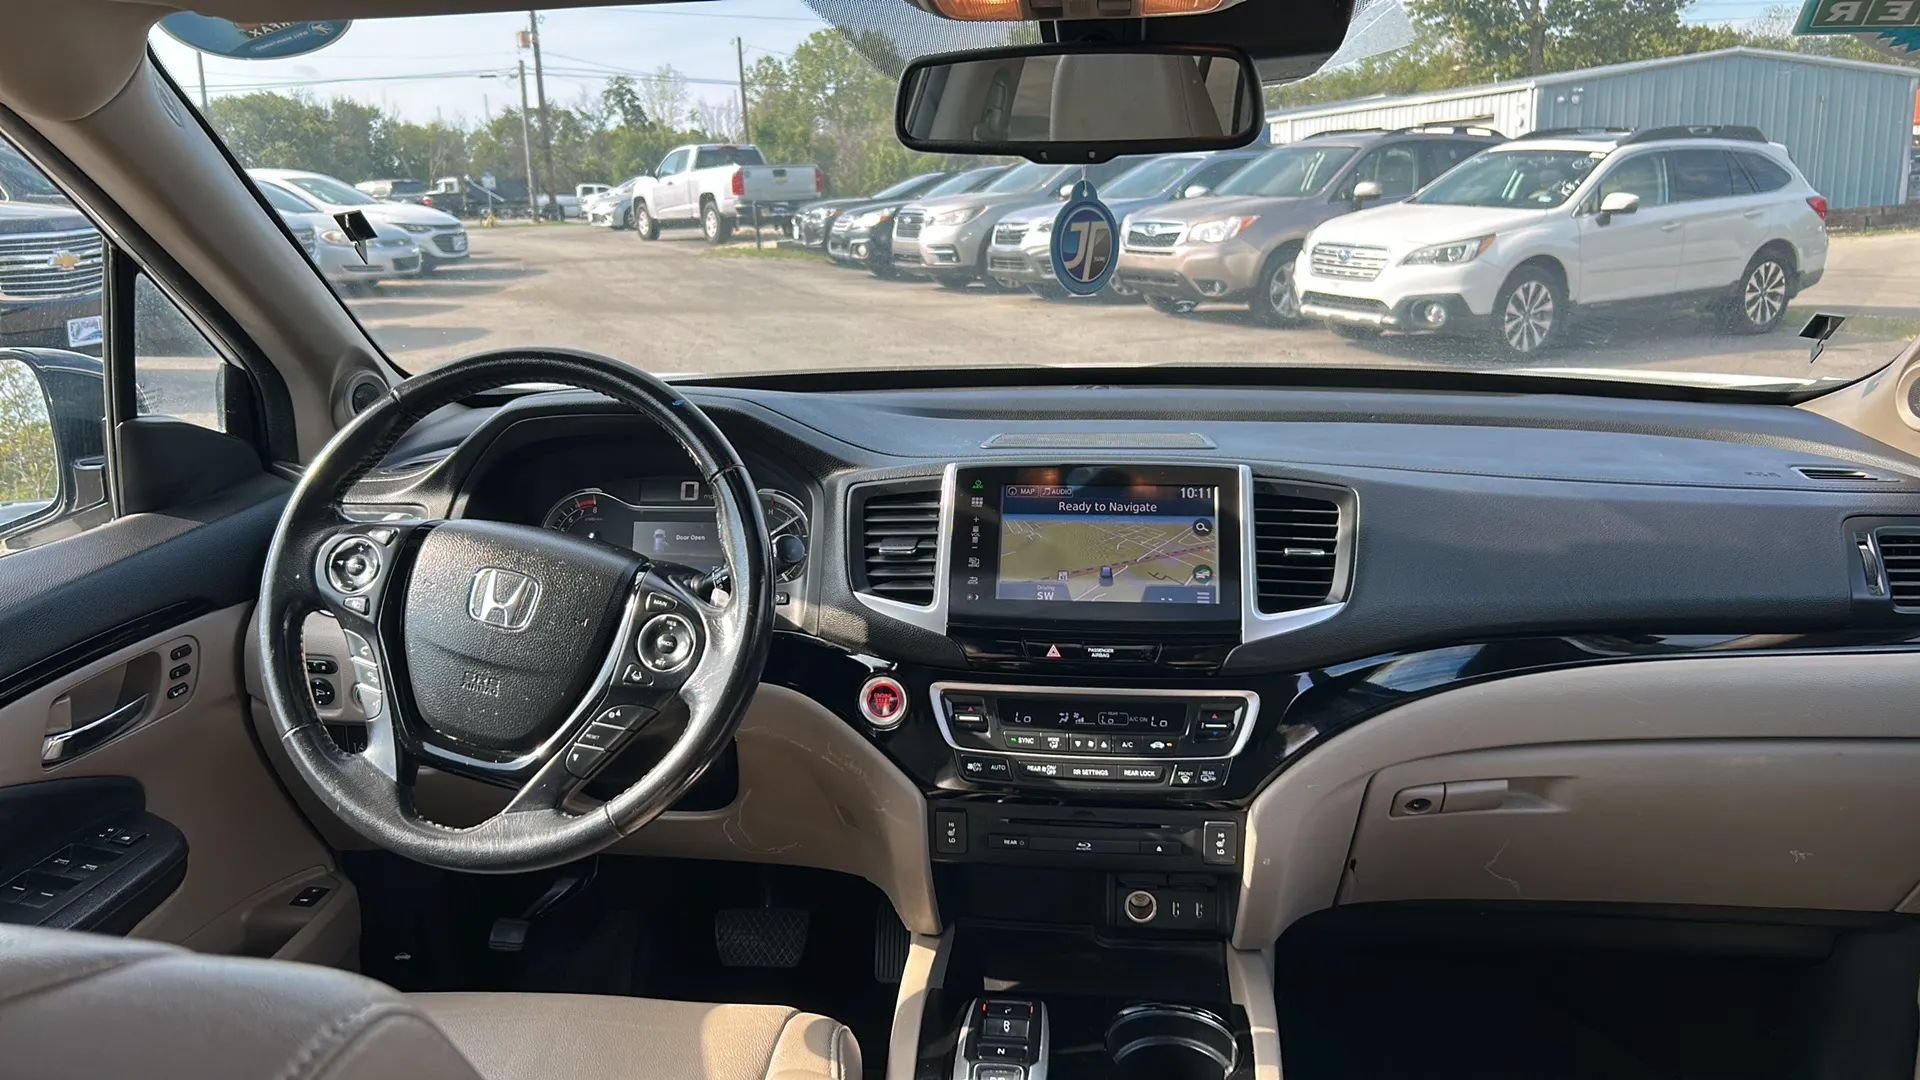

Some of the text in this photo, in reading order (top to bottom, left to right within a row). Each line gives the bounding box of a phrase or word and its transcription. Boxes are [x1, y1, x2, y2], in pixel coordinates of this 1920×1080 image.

[1051, 487, 1072, 496] AUDIO
[1180, 487, 1212, 499] 10:11
[1058, 501, 1158, 514] Ready to Navigate
[690, 534, 706, 542] Open
[1036, 591, 1055, 601] SW
[1123, 769, 1138, 777] REAR
